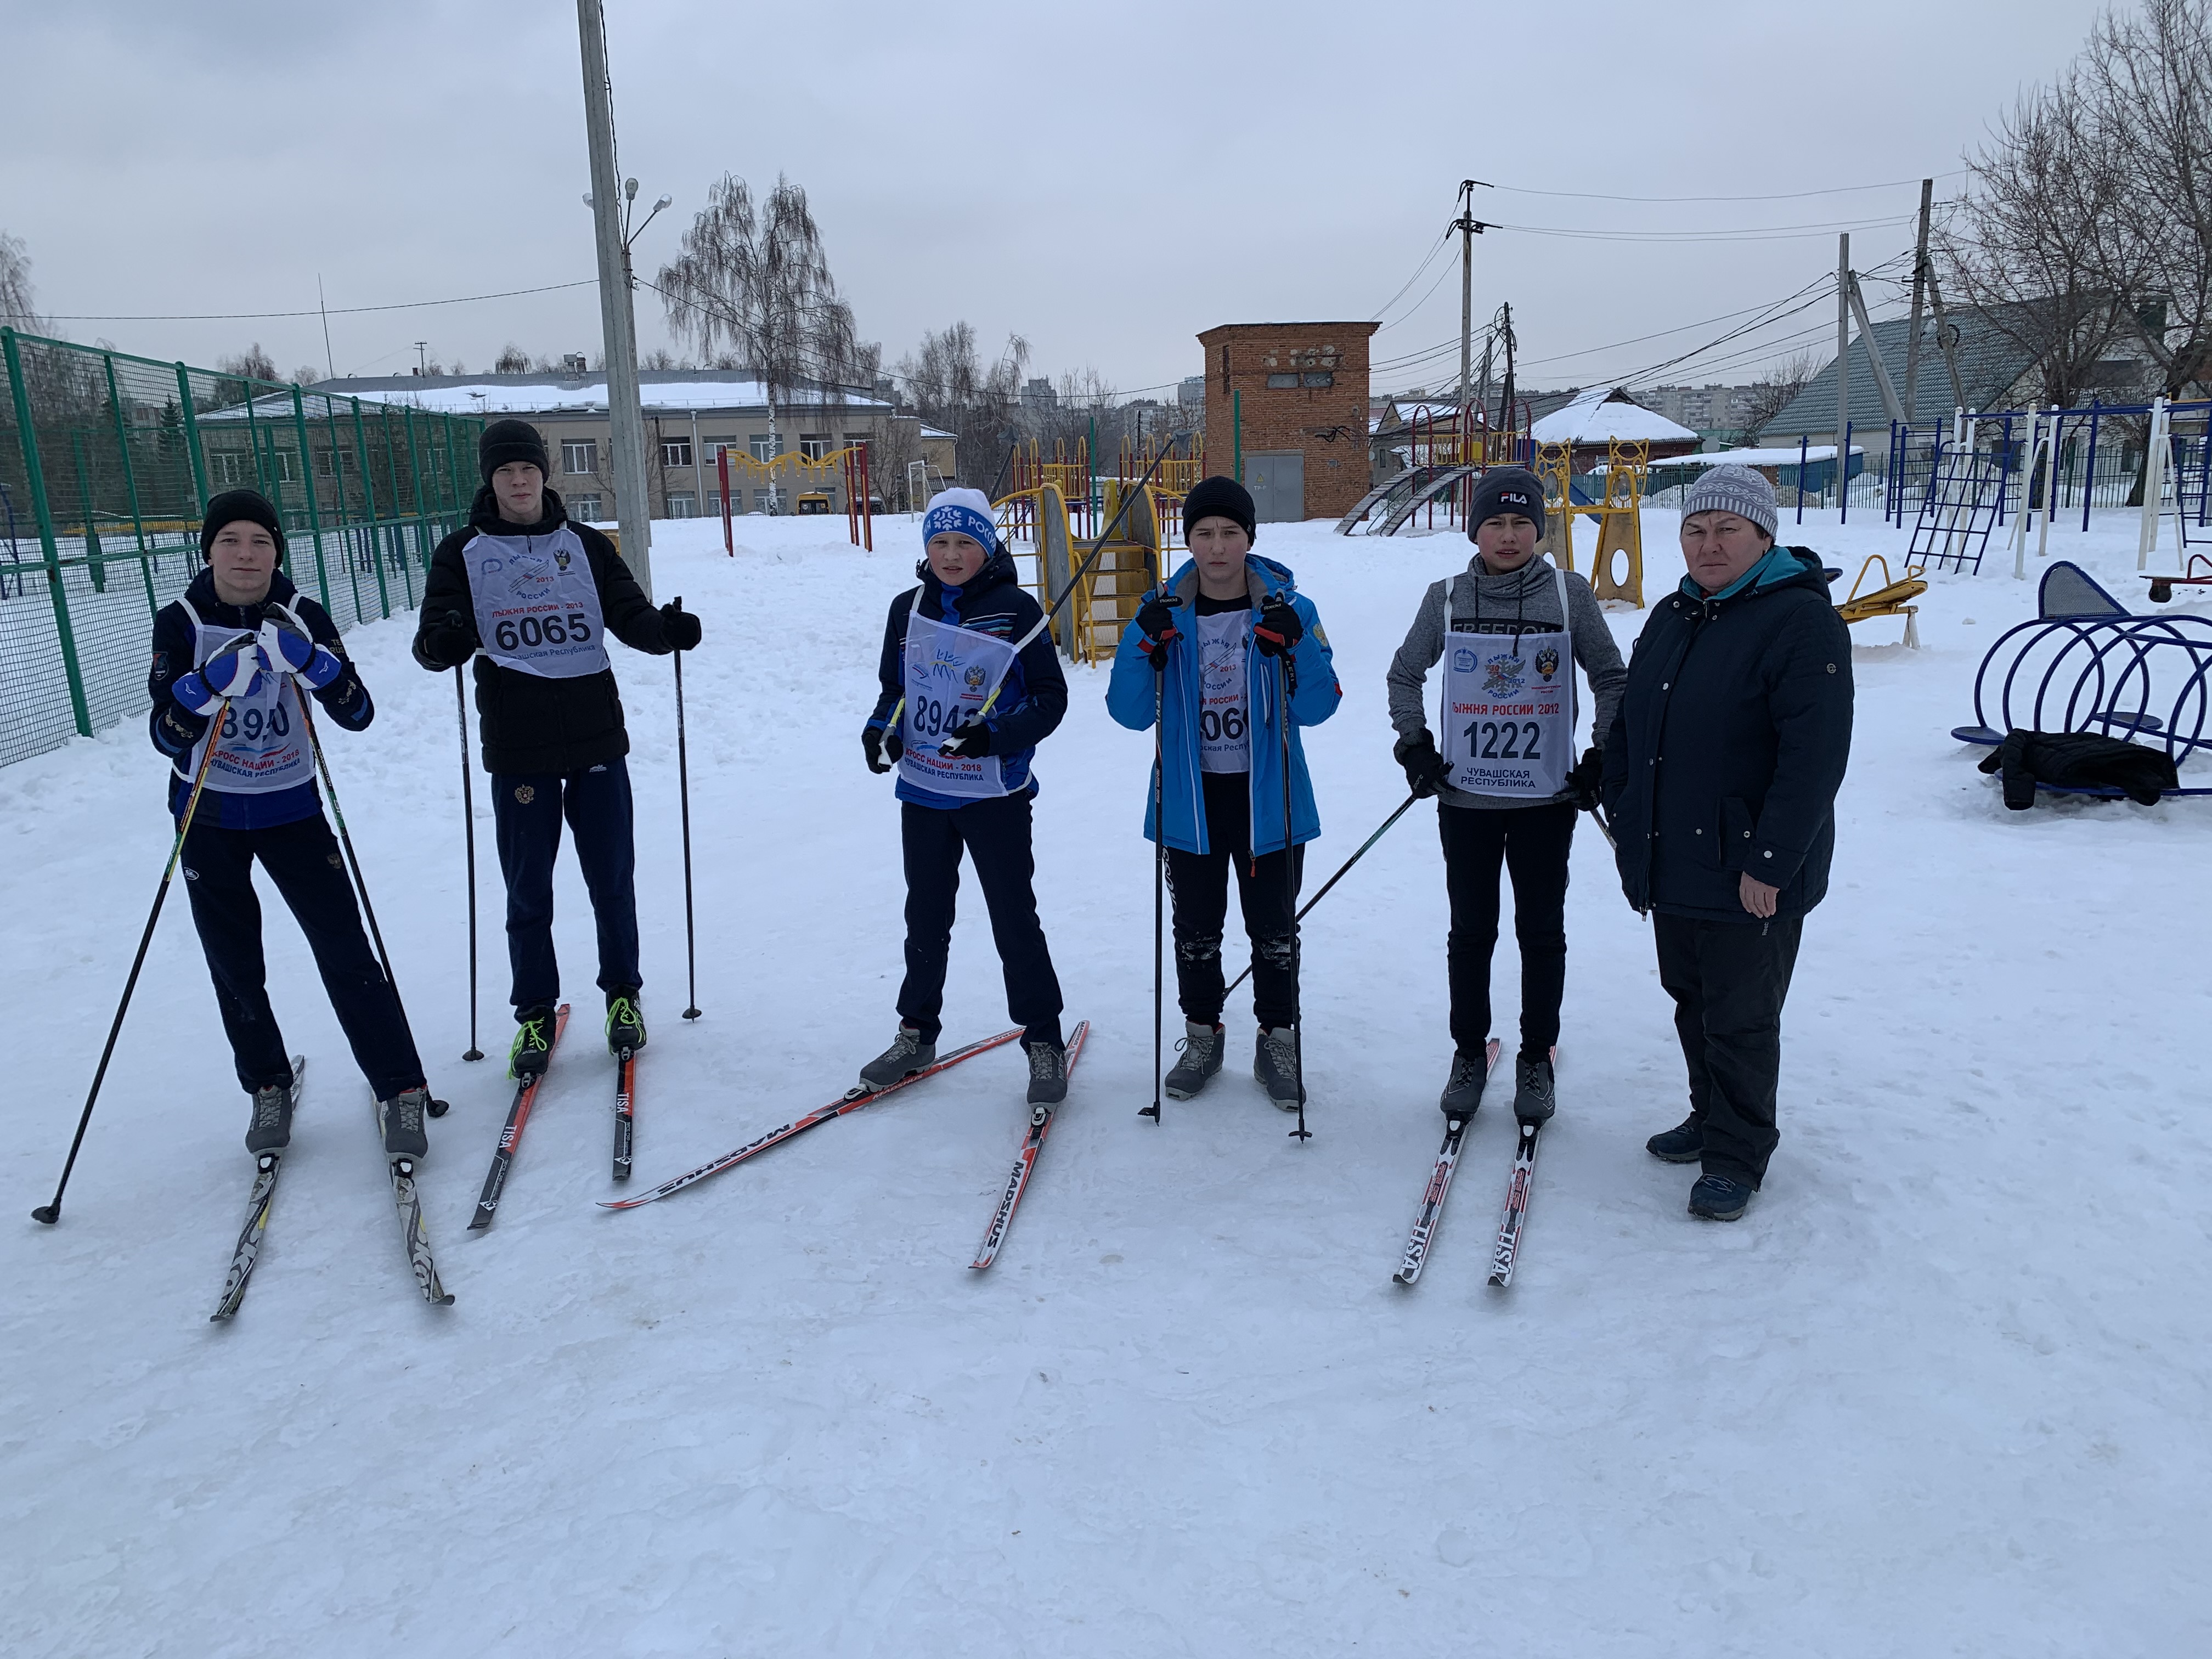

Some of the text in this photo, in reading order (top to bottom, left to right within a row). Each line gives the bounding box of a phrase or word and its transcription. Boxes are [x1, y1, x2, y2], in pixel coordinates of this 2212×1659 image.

[1501, 493, 1527, 504] FILA
[516, 588, 550, 600] РОССИИ
[492, 607, 524, 618] ЛЫЖНЯ
[527, 604, 559, 613] РОССИИ
[495, 613, 591, 651] 6065
[550, 644, 596, 656] Республика
[1285, 660, 1294, 681] LEKI
[1209, 694, 1239, 705] РОССИИ
[1488, 689, 1519, 699] РОССИИ
[1492, 704, 1533, 715] РОССИИ
[1538, 703, 1559, 714] 2012
[1200, 707, 1249, 741] 06
[1464, 721, 1541, 760] 1222
[242, 758, 274, 771] НАЦИИ
[281, 749, 300, 763] 2018
[255, 758, 301, 778] РЕСПУБЛИКА
[904, 757, 984, 781] ЧУВАШСКАЯ РЕСПУБЛИКА
[906, 747, 926, 763] КРОСС
[927, 757, 953, 770] НАЦИИ
[961, 764, 981, 772] 2018
[1461, 776, 1536, 788] РЕСПУБЛИКА
[1466, 767, 1530, 779] ЧУВАШСКАЯ
[872, 1074, 924, 1100] MADSHUS
[617, 1092, 629, 1113] TISA
[499, 1125, 517, 1149] TISA
[657, 1123, 791, 1195] MADSHUS
[988, 1161, 1024, 1248] MADSHUS
[1401, 1224, 1431, 1269] TISA
[1492, 1231, 1517, 1274] TISA
